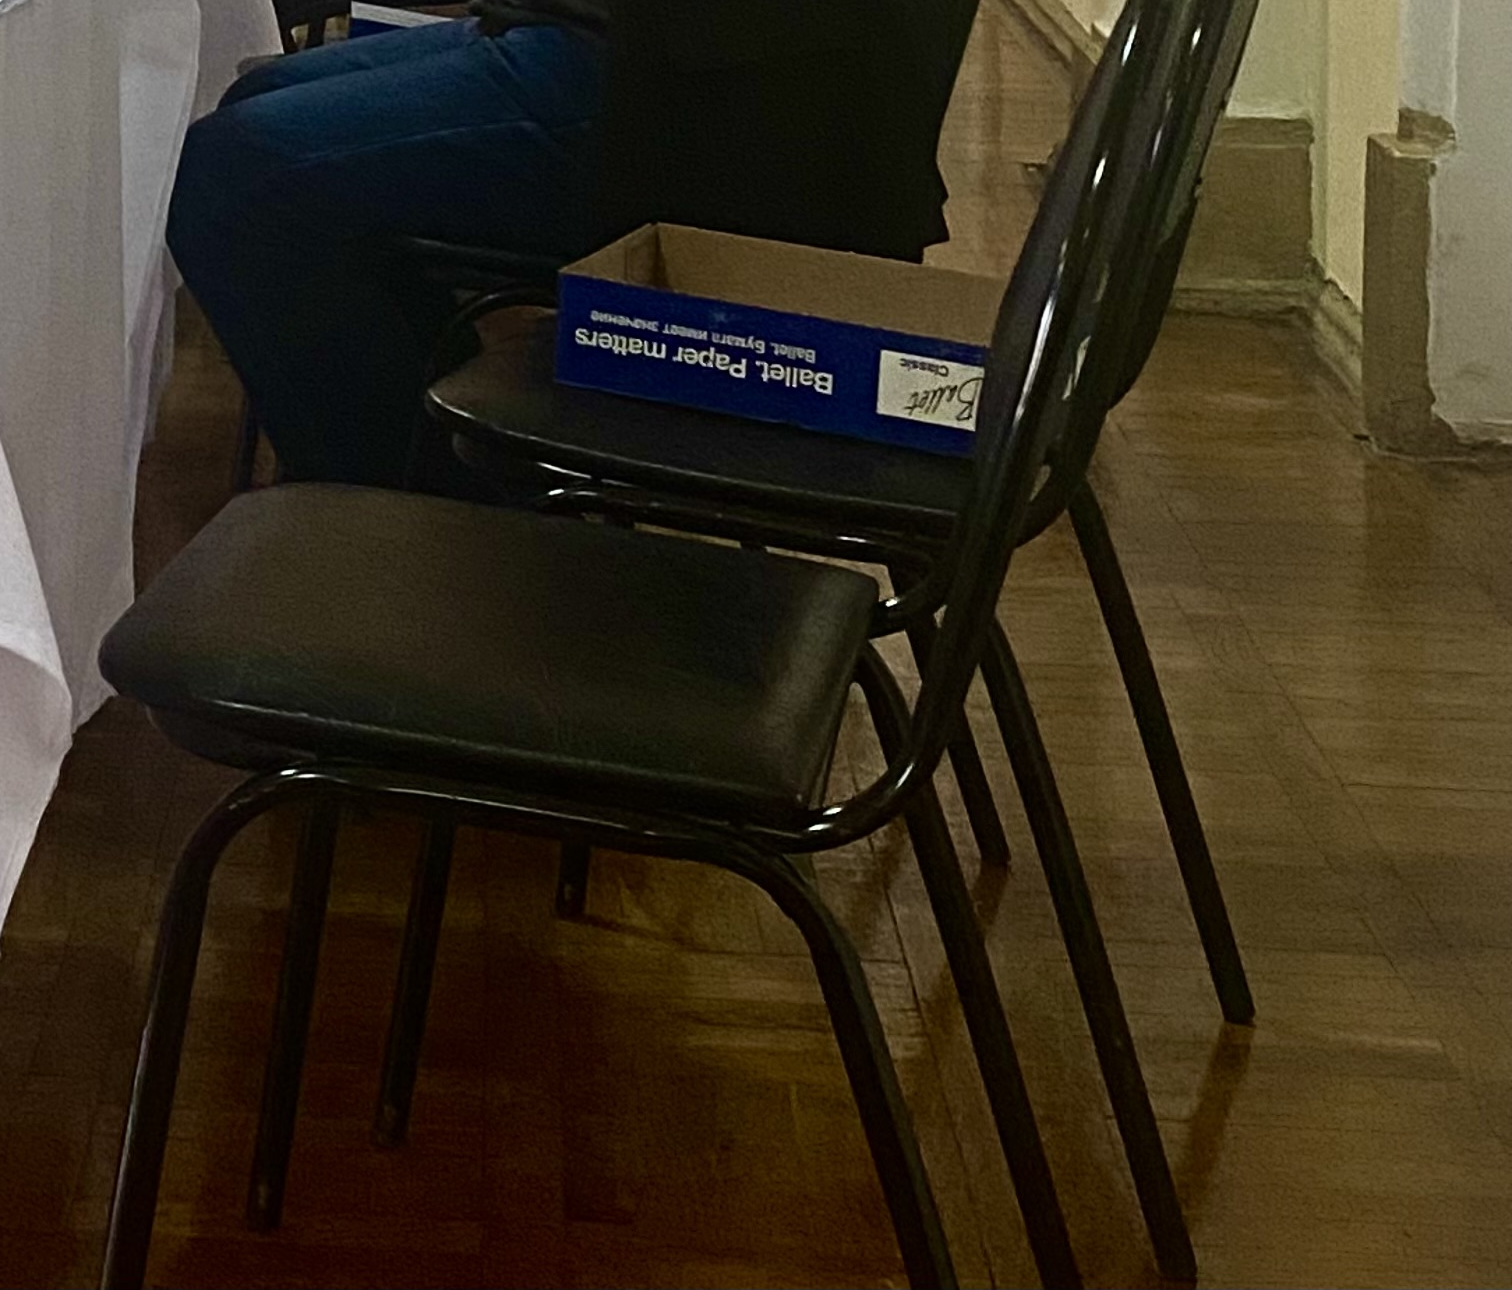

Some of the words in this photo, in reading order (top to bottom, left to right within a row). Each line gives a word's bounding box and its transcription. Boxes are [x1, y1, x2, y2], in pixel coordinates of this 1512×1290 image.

[590, 309, 660, 332] значение
[574, 327, 667, 360] matters
[672, 346, 748, 379] Paper
[755, 360, 834, 396] Ballet.
[899, 358, 949, 378] Classic
[903, 377, 984, 422] Ballet
